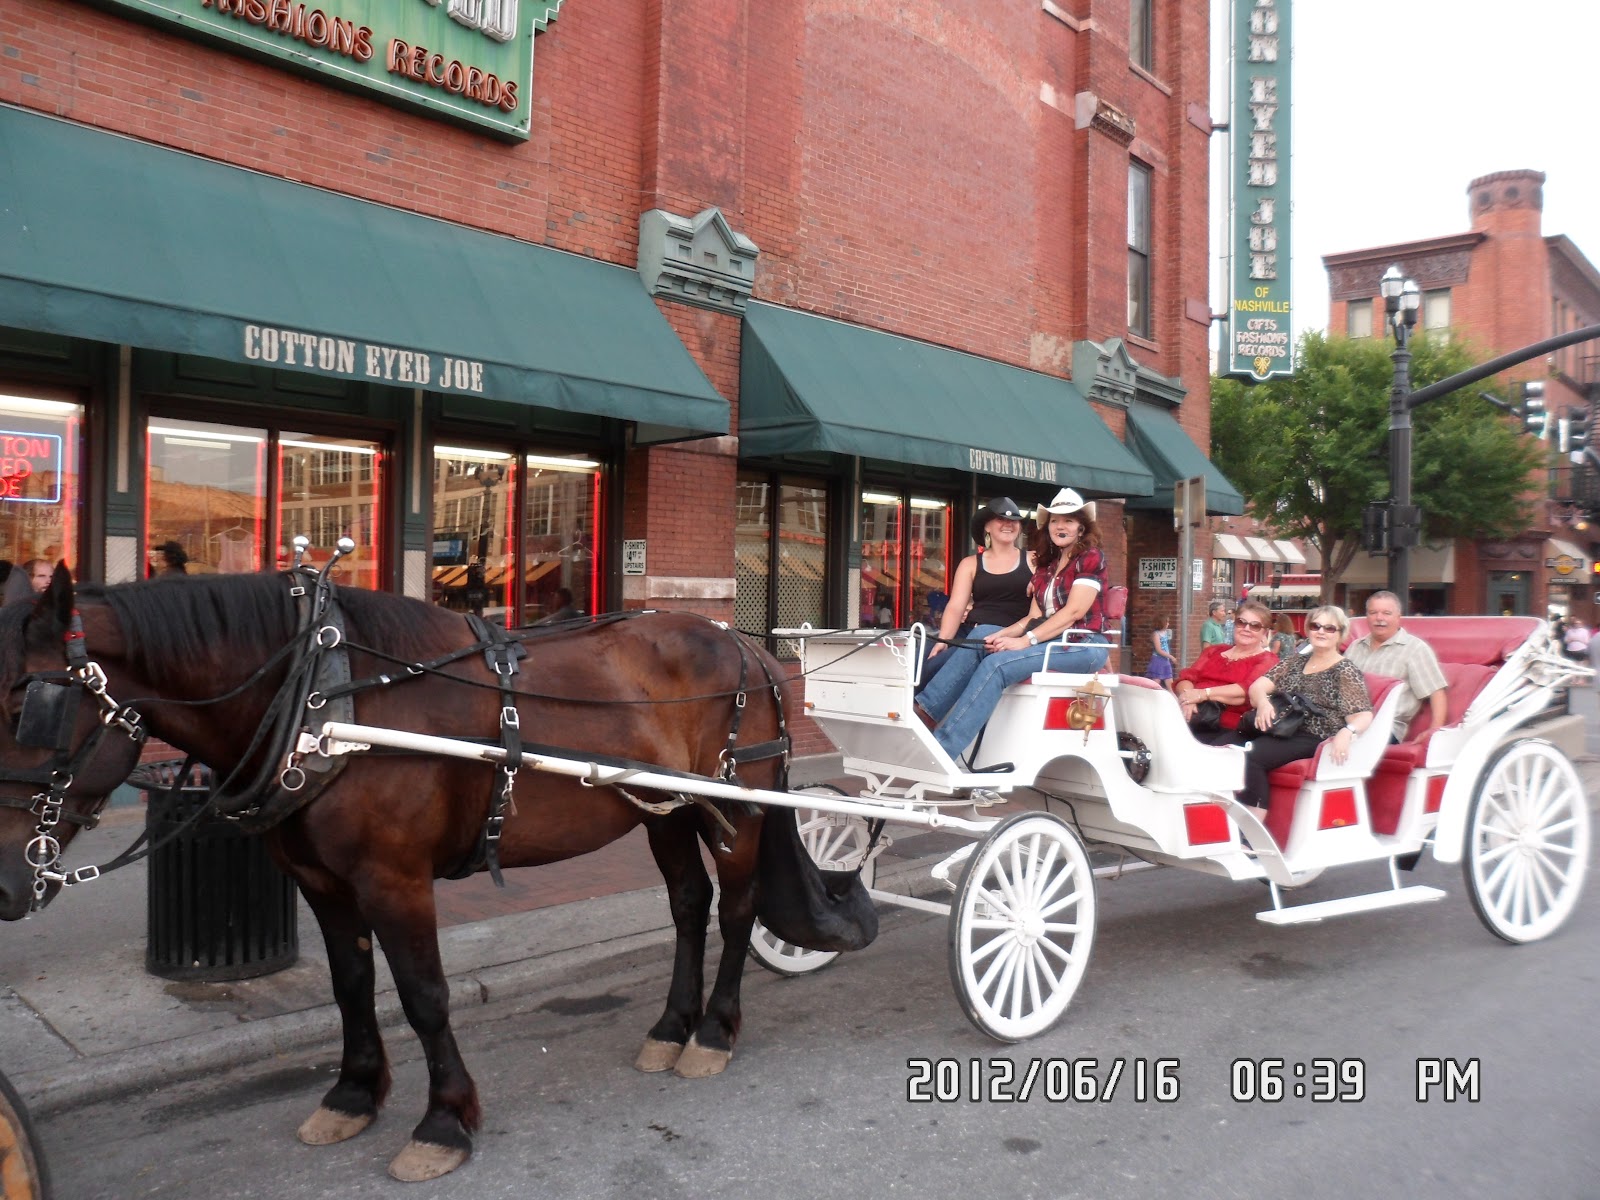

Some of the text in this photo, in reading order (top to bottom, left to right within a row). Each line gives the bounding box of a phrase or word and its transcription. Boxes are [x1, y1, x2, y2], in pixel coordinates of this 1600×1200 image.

[202, 0, 374, 62] SHIONS
[387, 38, 519, 113] RECORDS
[1247, 0, 1280, 281] ON EYED JOE
[1254, 286, 1270, 298] OF
[1234, 299, 1290, 313] NASHVILLE
[1235, 330, 1288, 345] FASHIONS
[1237, 344, 1287, 358] RECORDS
[244, 324, 484, 393] COTTON EYED JOE
[969, 448, 1056, 481] COTTON EYED JOE
[624, 541, 646, 550] T-SHIRTS
[1141, 562, 1175, 571] T-SHIRTS
